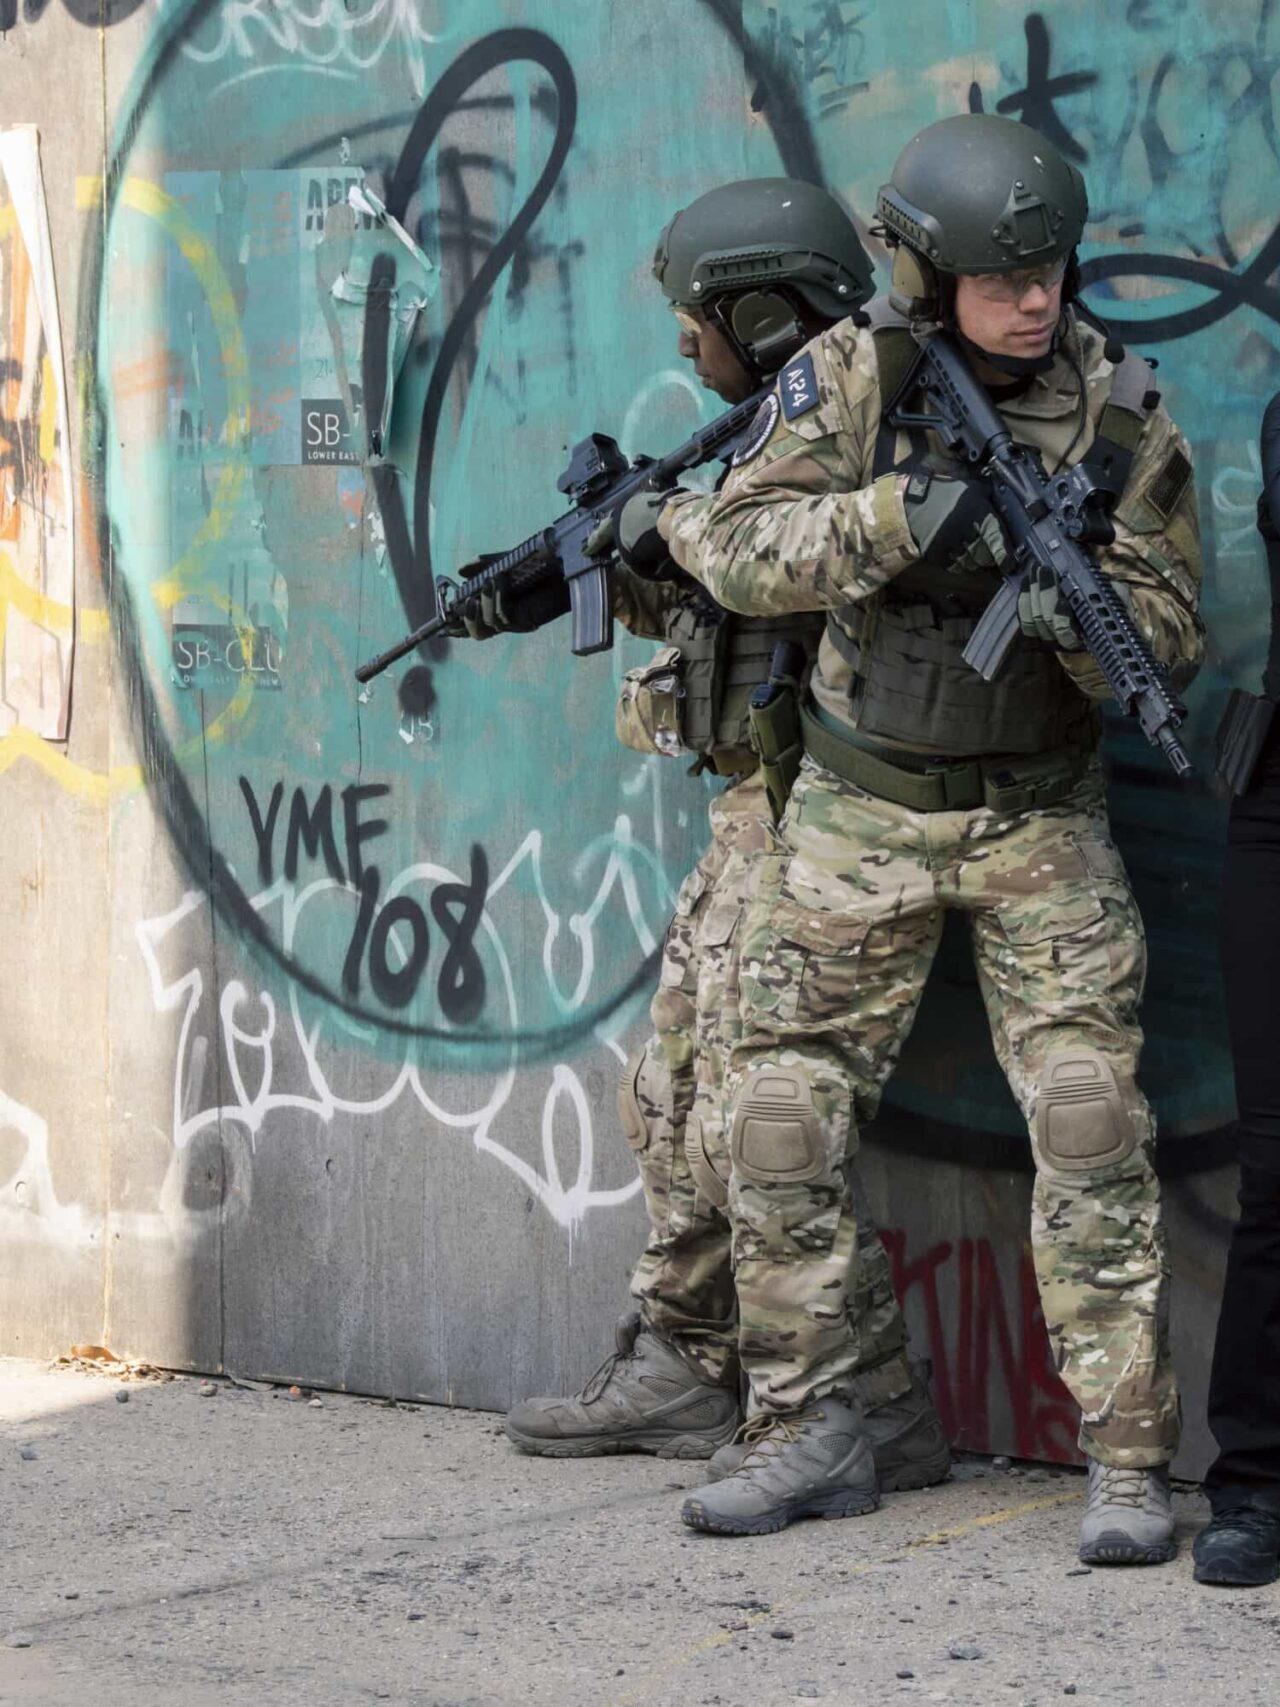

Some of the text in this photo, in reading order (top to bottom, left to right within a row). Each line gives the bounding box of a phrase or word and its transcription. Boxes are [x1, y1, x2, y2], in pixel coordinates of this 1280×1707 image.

[787, 368, 809, 408] A24
[308, 451, 336, 460] LOWER
[342, 842, 489, 1025] 108
